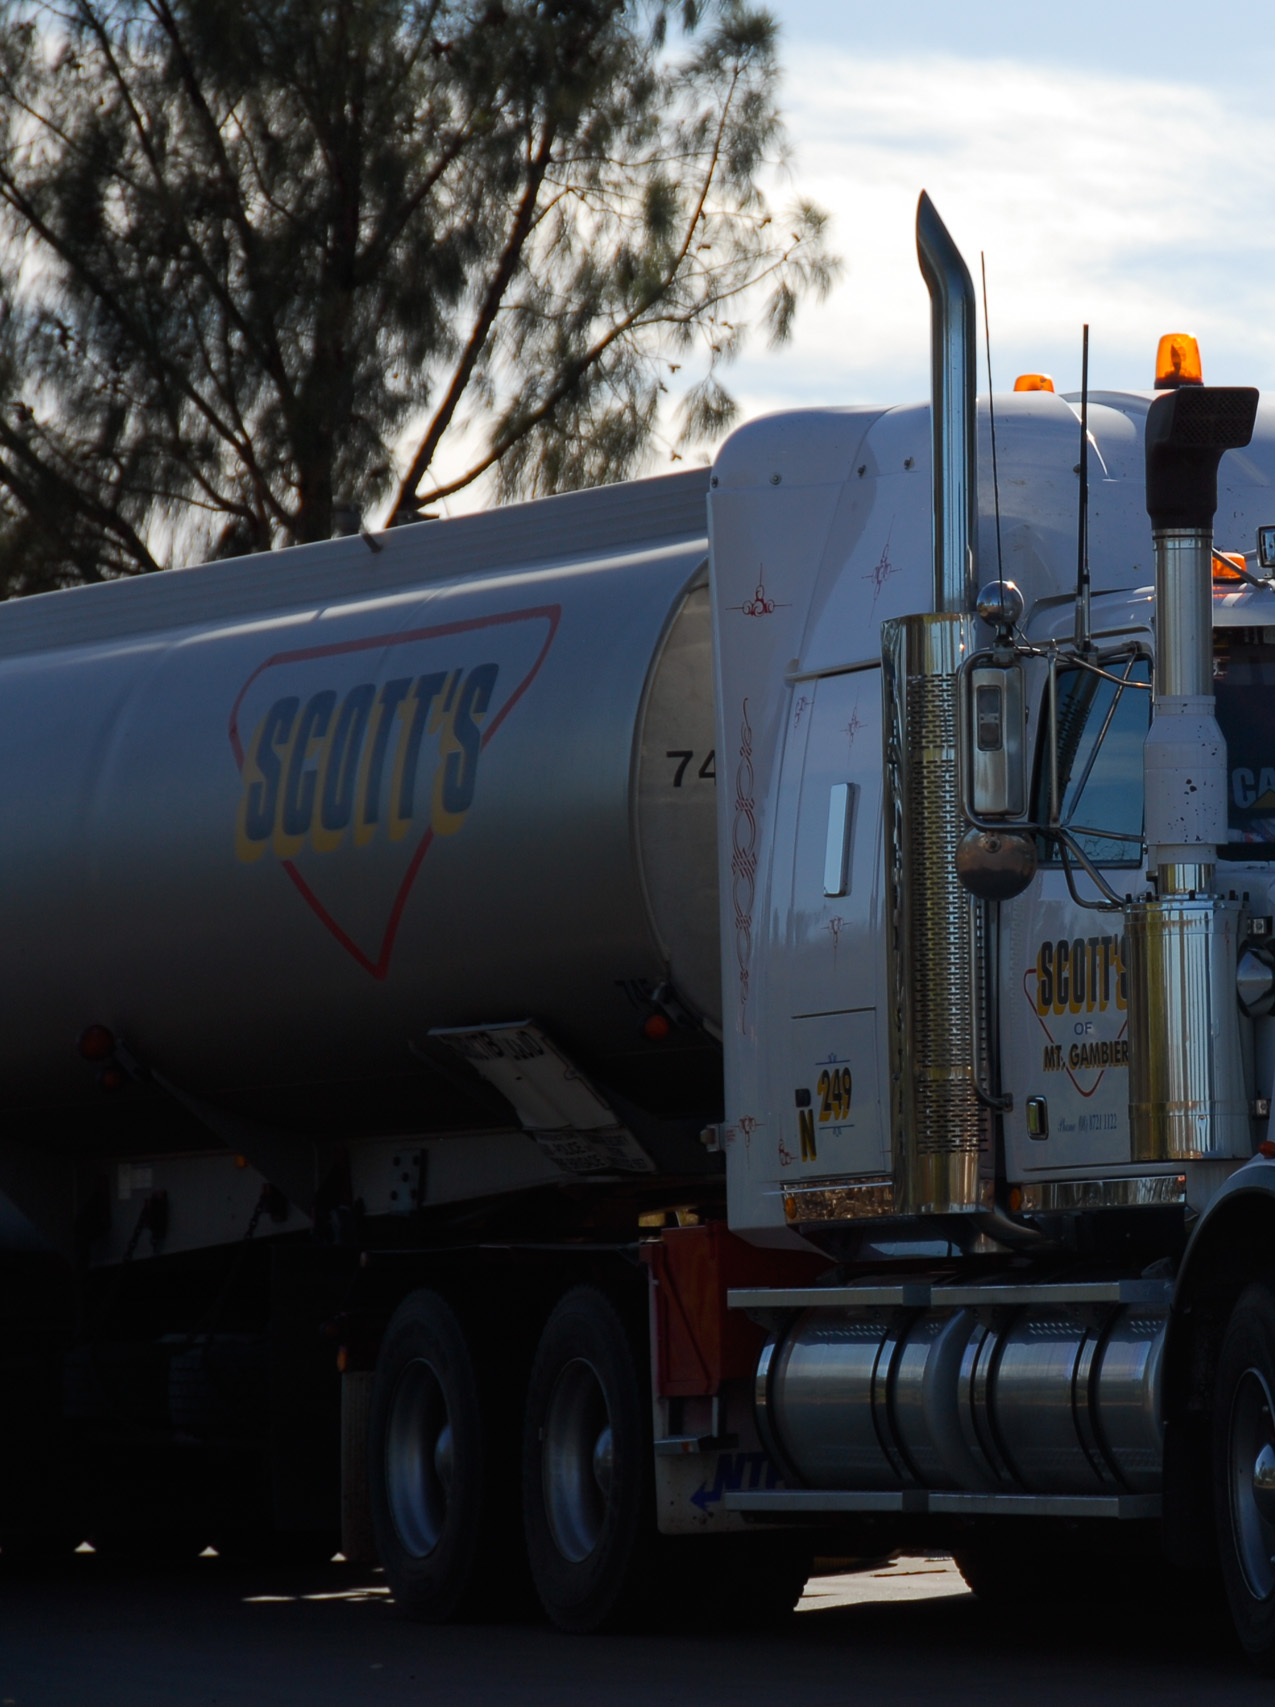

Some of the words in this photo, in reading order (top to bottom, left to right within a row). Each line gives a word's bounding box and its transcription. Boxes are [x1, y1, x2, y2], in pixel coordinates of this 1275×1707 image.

[235, 662, 499, 862] SCOTT'S
[1074, 1022, 1094, 1036] OF
[1069, 1040, 1129, 1070] GAMBIER
[817, 1067, 852, 1122] 249
